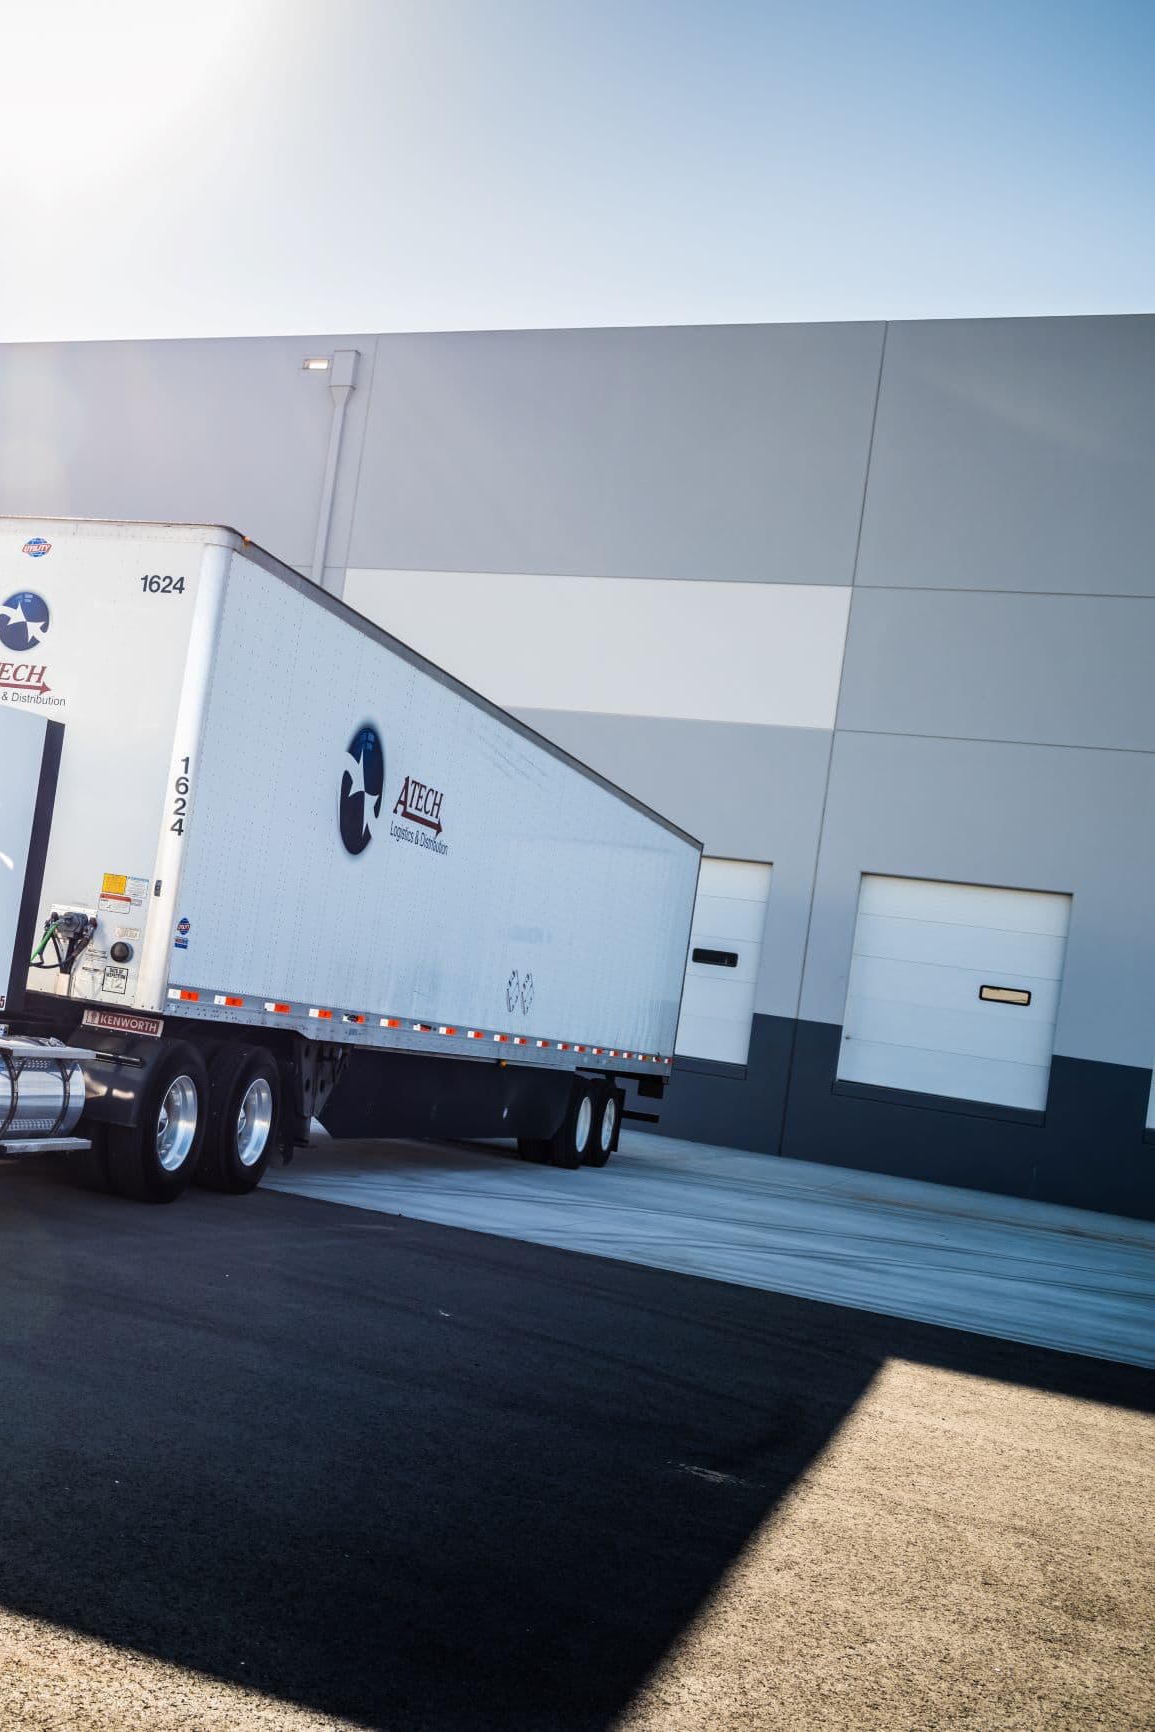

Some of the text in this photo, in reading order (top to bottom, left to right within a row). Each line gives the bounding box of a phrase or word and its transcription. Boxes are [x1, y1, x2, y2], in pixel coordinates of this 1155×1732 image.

[140, 575, 185, 594] 1624
[1, 691, 8, 701] &
[11, 692, 66, 706] Distribution
[393, 775, 444, 819] ATECH
[390, 820, 448, 855] Logistics & Distribution
[100, 1014, 158, 1033] KENWORTH
